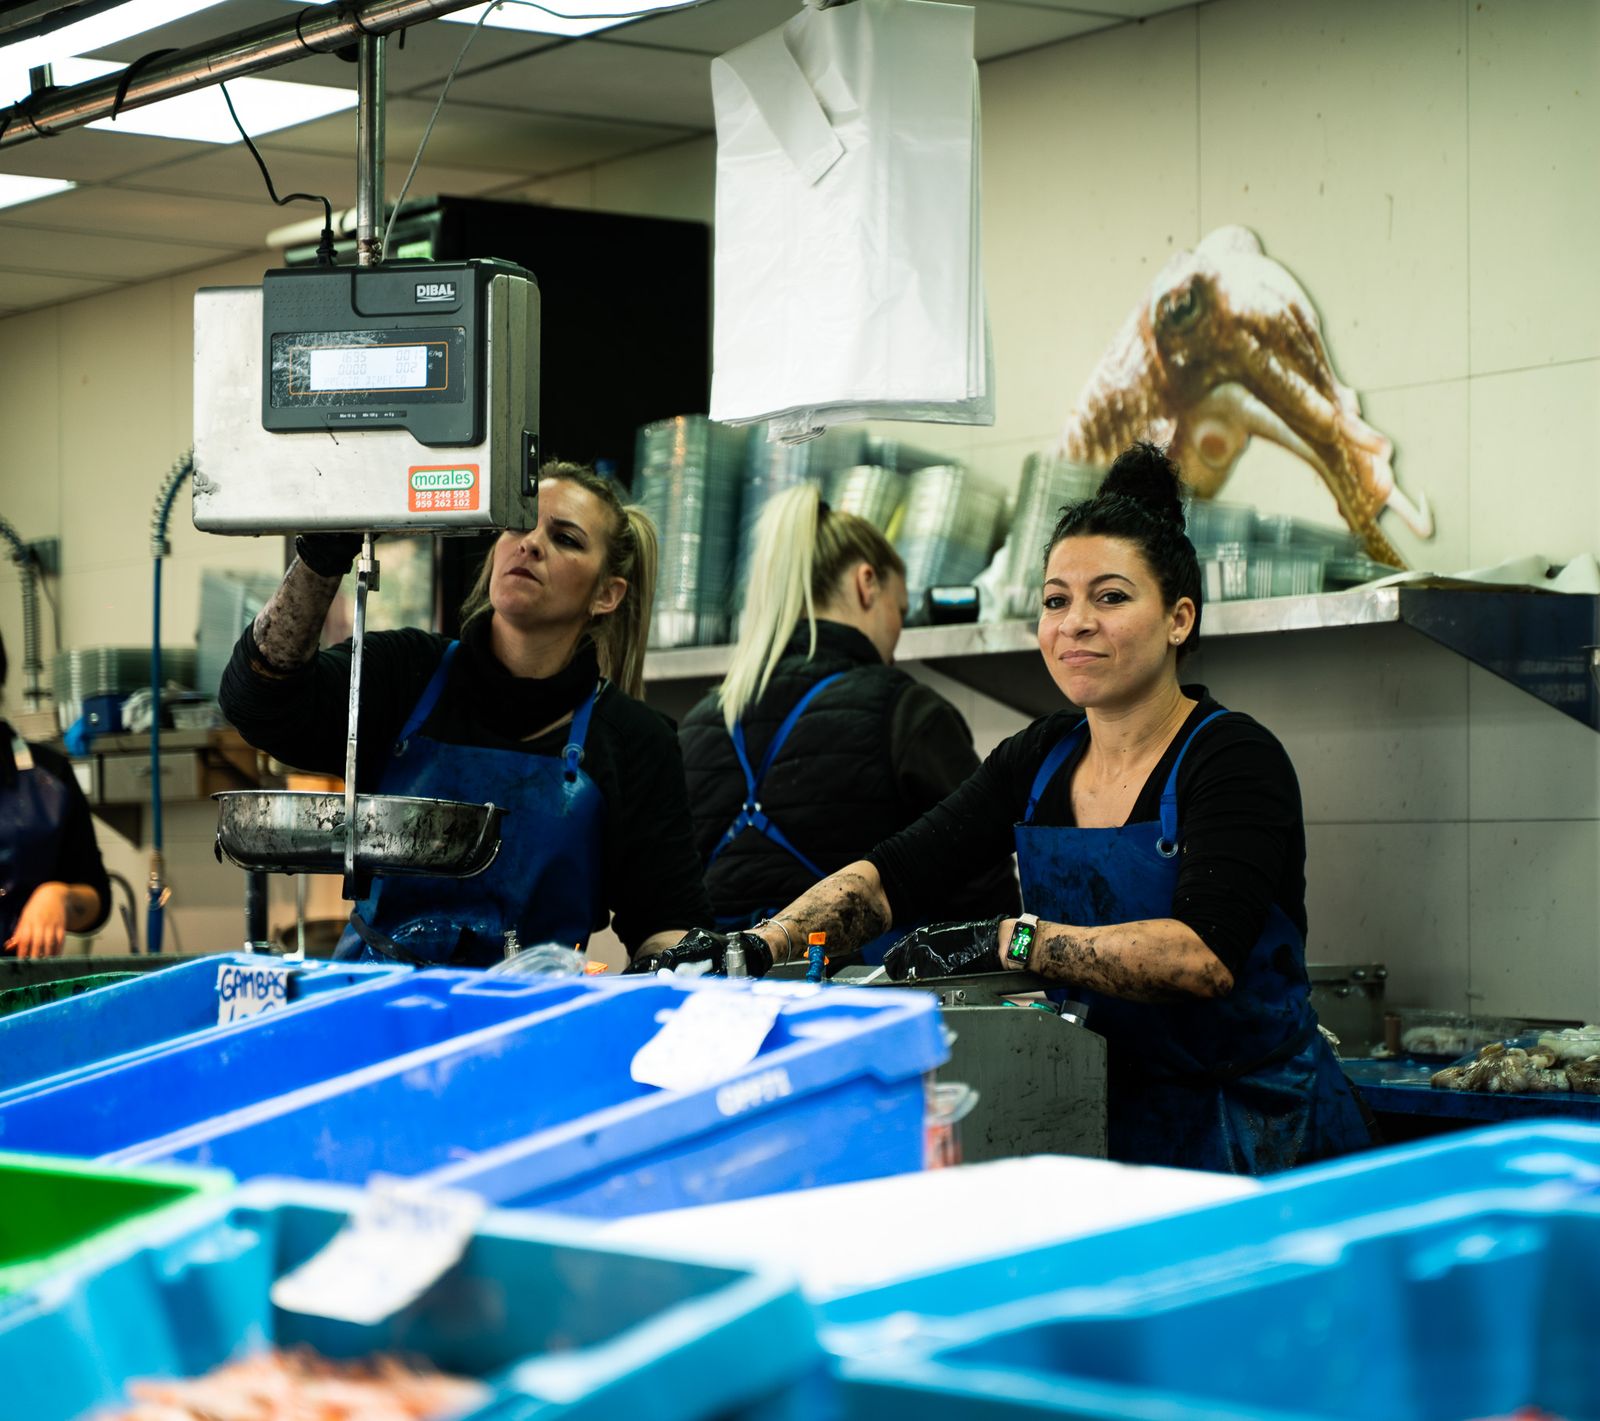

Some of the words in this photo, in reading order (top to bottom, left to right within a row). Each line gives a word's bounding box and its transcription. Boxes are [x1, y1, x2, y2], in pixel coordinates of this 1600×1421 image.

[416, 283, 455, 296] DIBAL
[415, 469, 471, 486] morales
[415, 491, 432, 499] 959
[434, 490, 451, 499] 246
[453, 490, 470, 498] 593
[415, 500, 432, 508] 959
[434, 499, 451, 508] 262
[453, 498, 470, 507] 102
[220, 968, 287, 1001] GAMBAS
